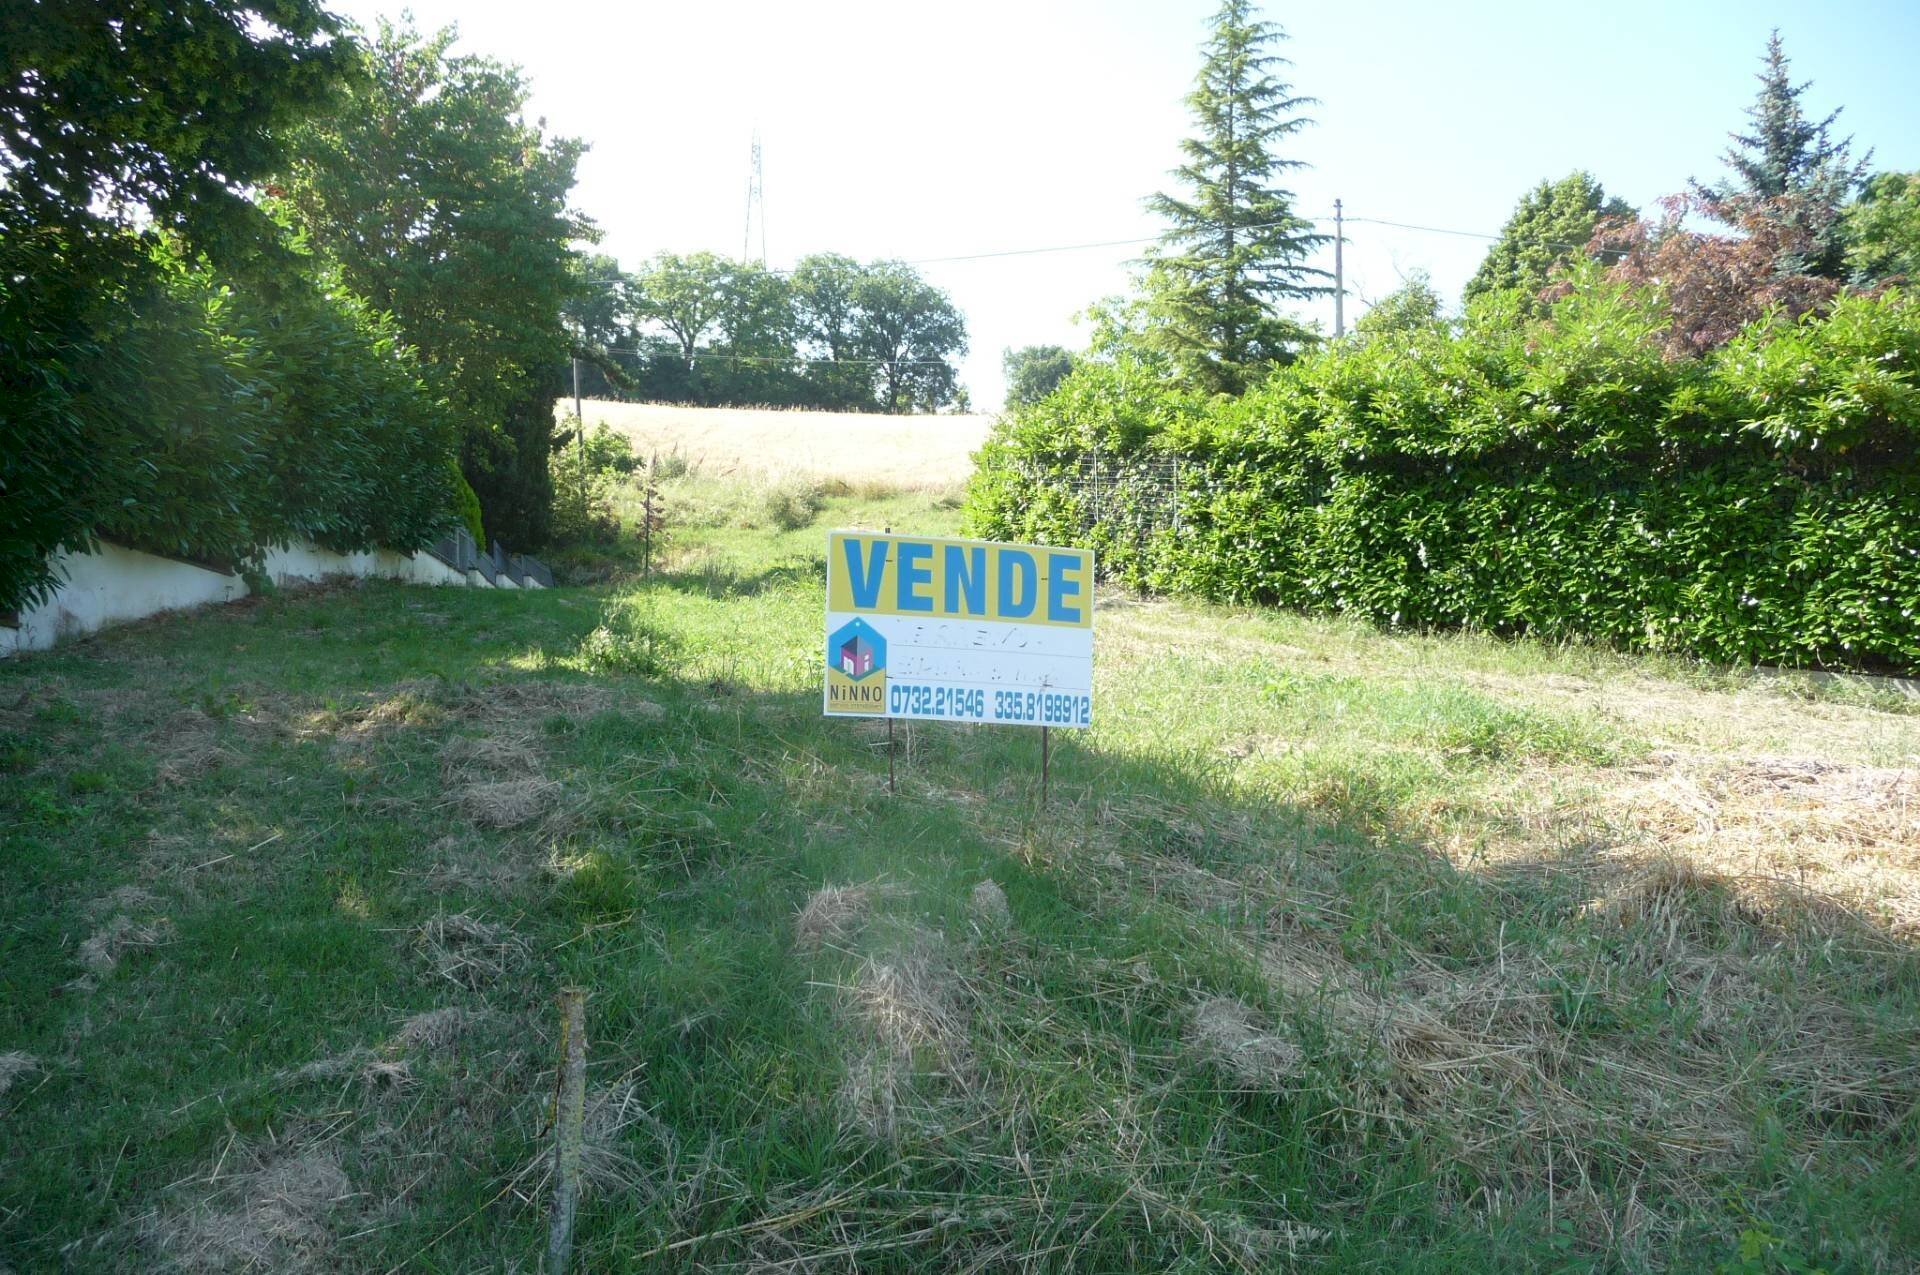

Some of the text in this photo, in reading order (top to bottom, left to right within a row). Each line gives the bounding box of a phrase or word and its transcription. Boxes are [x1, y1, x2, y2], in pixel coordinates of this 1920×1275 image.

[843, 539, 1081, 623] VENDE
[891, 685, 1090, 724] 0732.21546 335.8198912
